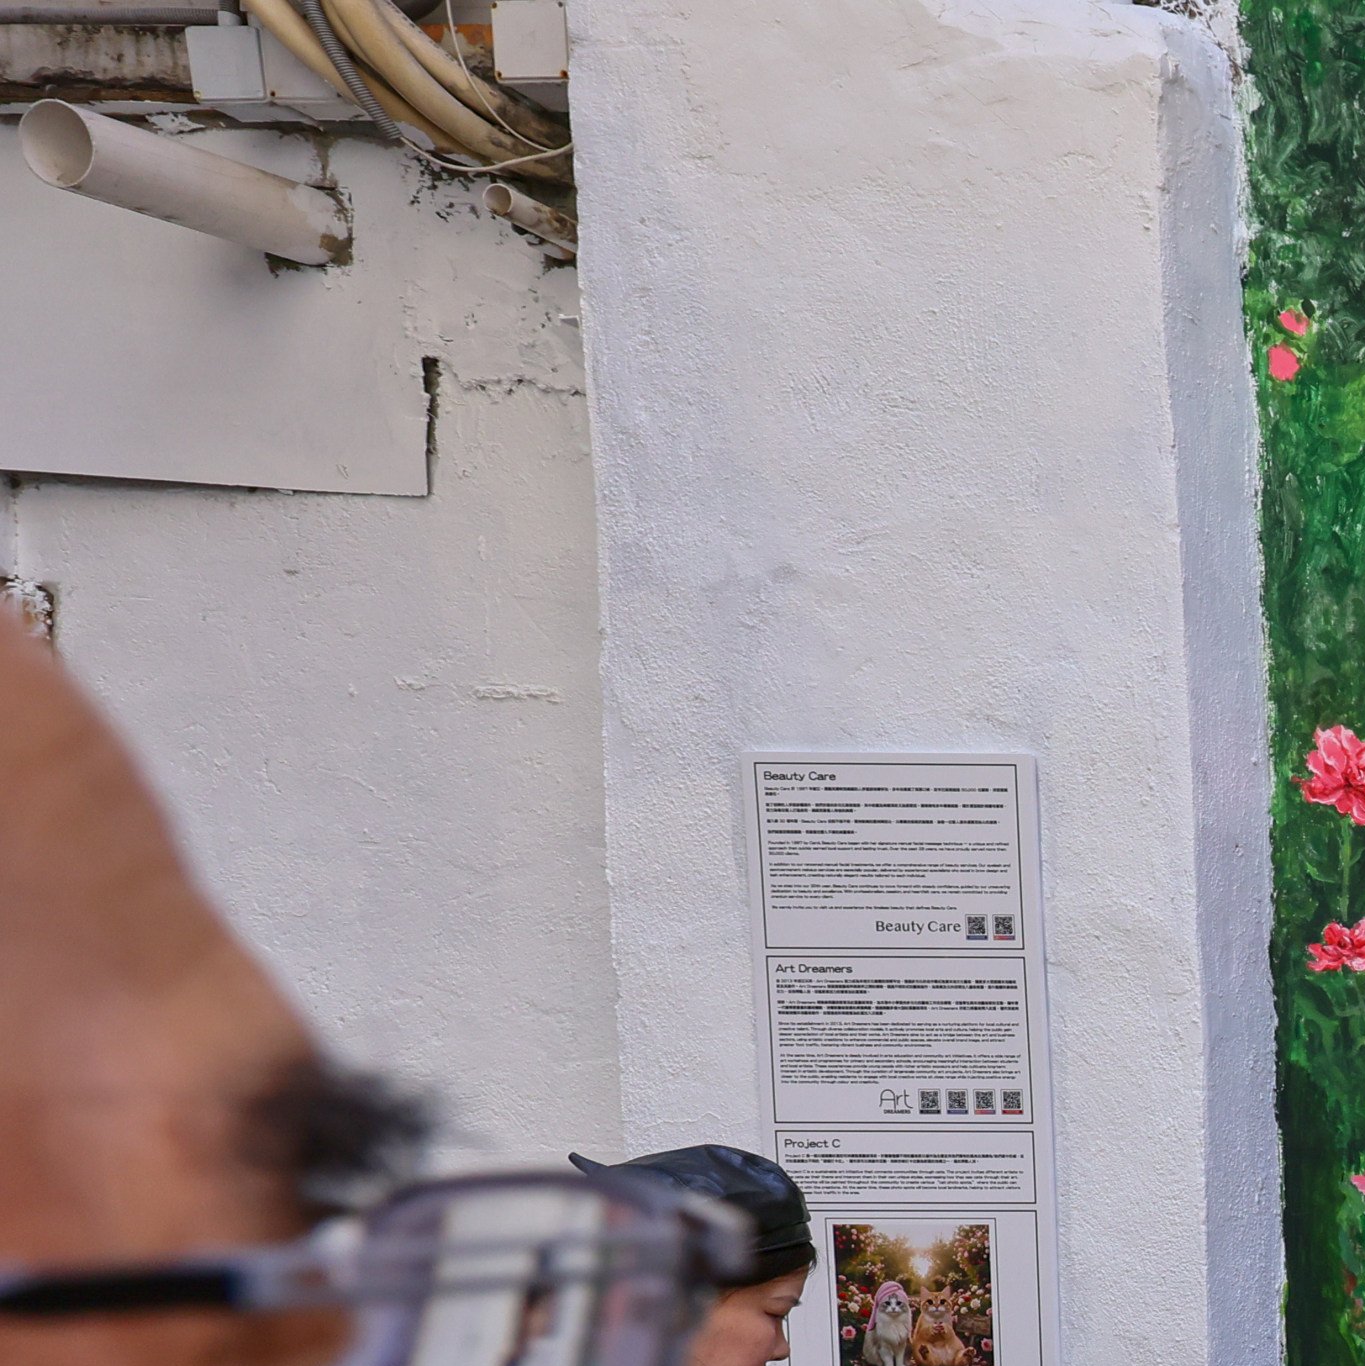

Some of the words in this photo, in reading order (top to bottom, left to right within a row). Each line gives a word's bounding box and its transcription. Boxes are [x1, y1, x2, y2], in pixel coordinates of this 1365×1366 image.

[764, 771, 805, 781] Beauty
[809, 771, 836, 781] Care
[876, 921, 924, 935] Beauty
[928, 921, 961, 932] Care
[776, 964, 795, 973] Art
[799, 964, 853, 973] Dreamers
[879, 1088, 913, 1112] Art
[784, 1139, 829, 1149] Project
[832, 1139, 840, 1148] C
